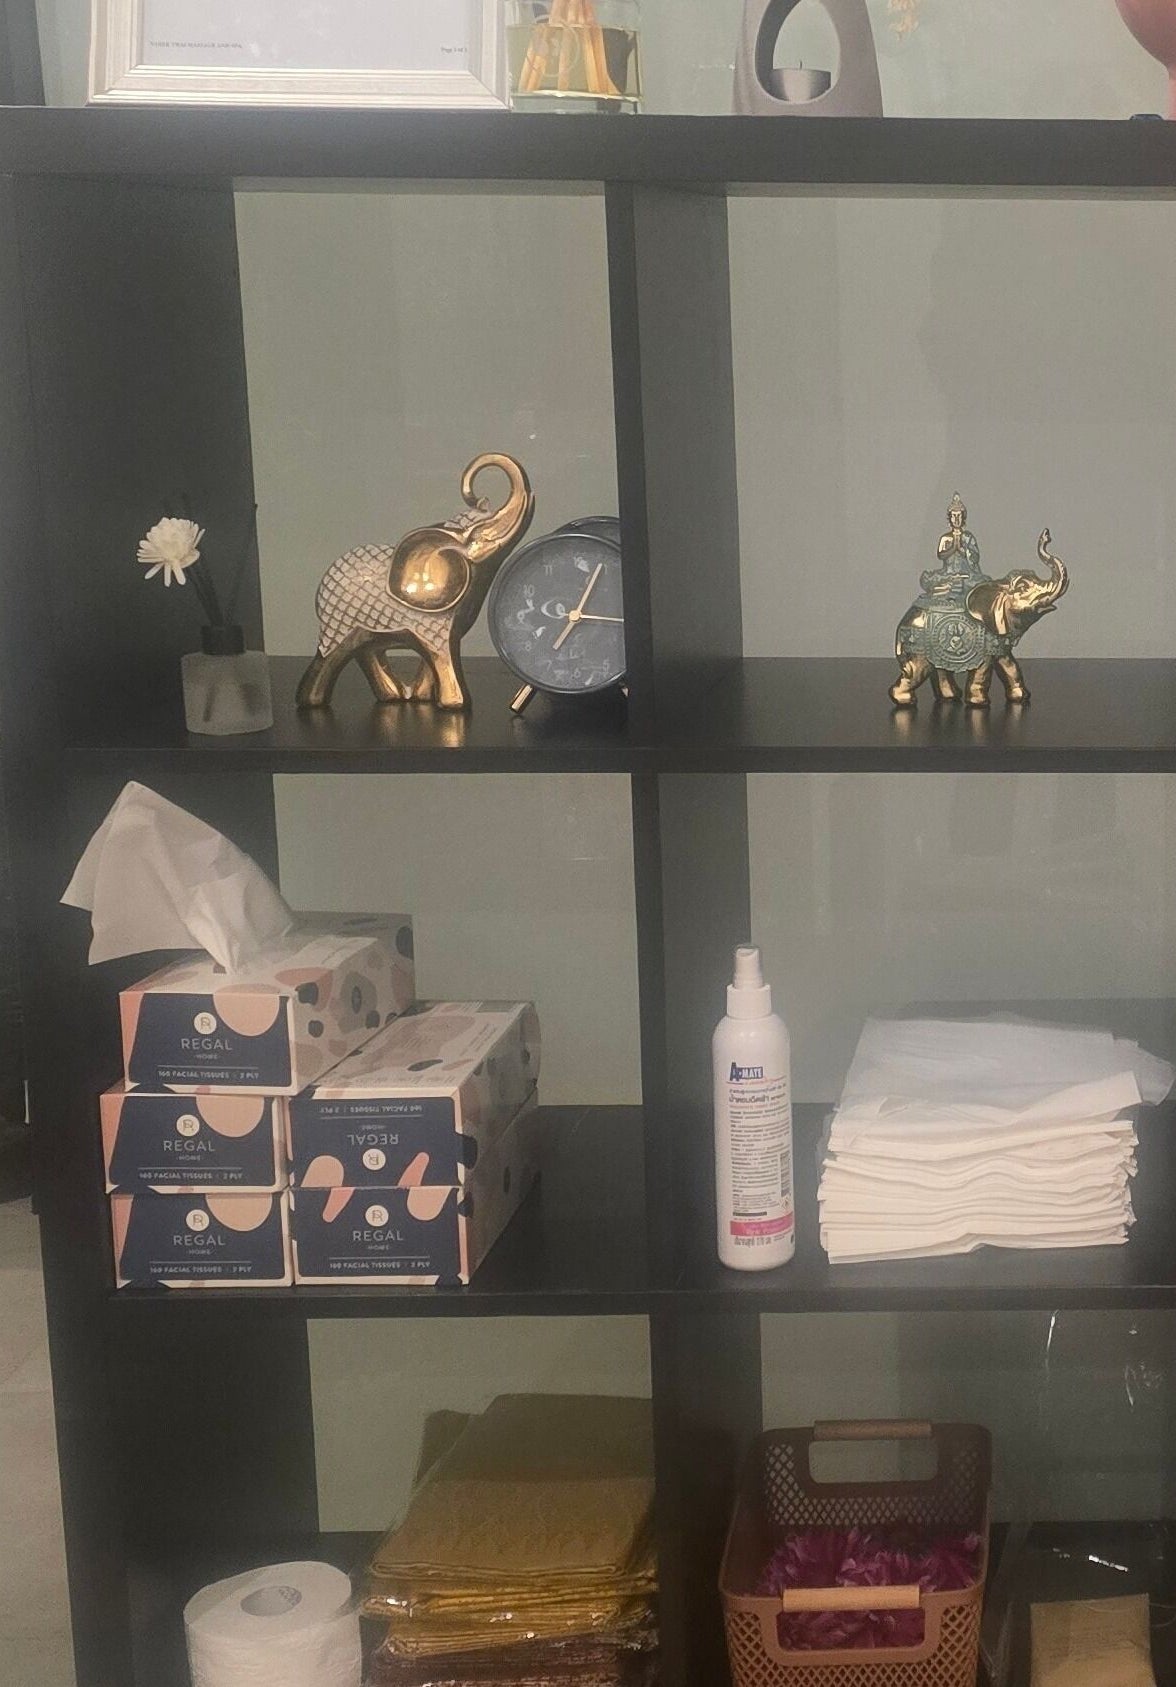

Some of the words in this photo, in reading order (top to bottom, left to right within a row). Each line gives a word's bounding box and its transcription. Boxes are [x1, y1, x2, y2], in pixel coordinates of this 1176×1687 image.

[181, 1038, 233, 1051] REGAL
[347, 1134, 399, 1145] REGAL
[163, 1140, 215, 1152] REGAL
[173, 1234, 226, 1246] REGAL
[352, 1230, 403, 1242] REGAL
